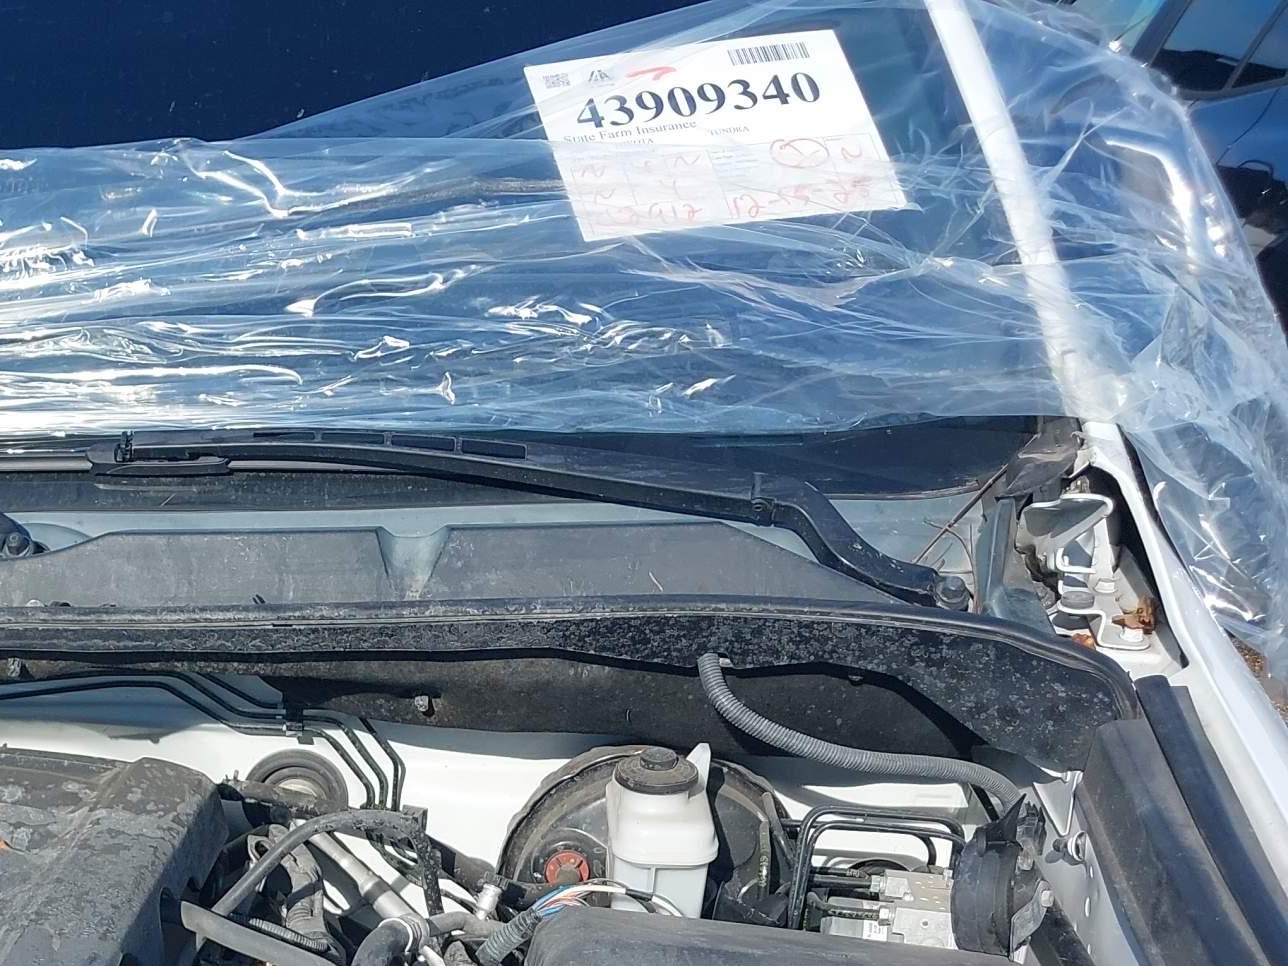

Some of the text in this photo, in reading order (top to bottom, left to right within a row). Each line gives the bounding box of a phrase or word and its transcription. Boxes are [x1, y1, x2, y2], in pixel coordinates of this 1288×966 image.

[576, 71, 822, 129] 43909340
[599, 128, 634, 141] Farm
[635, 120, 697, 135] Insurance
